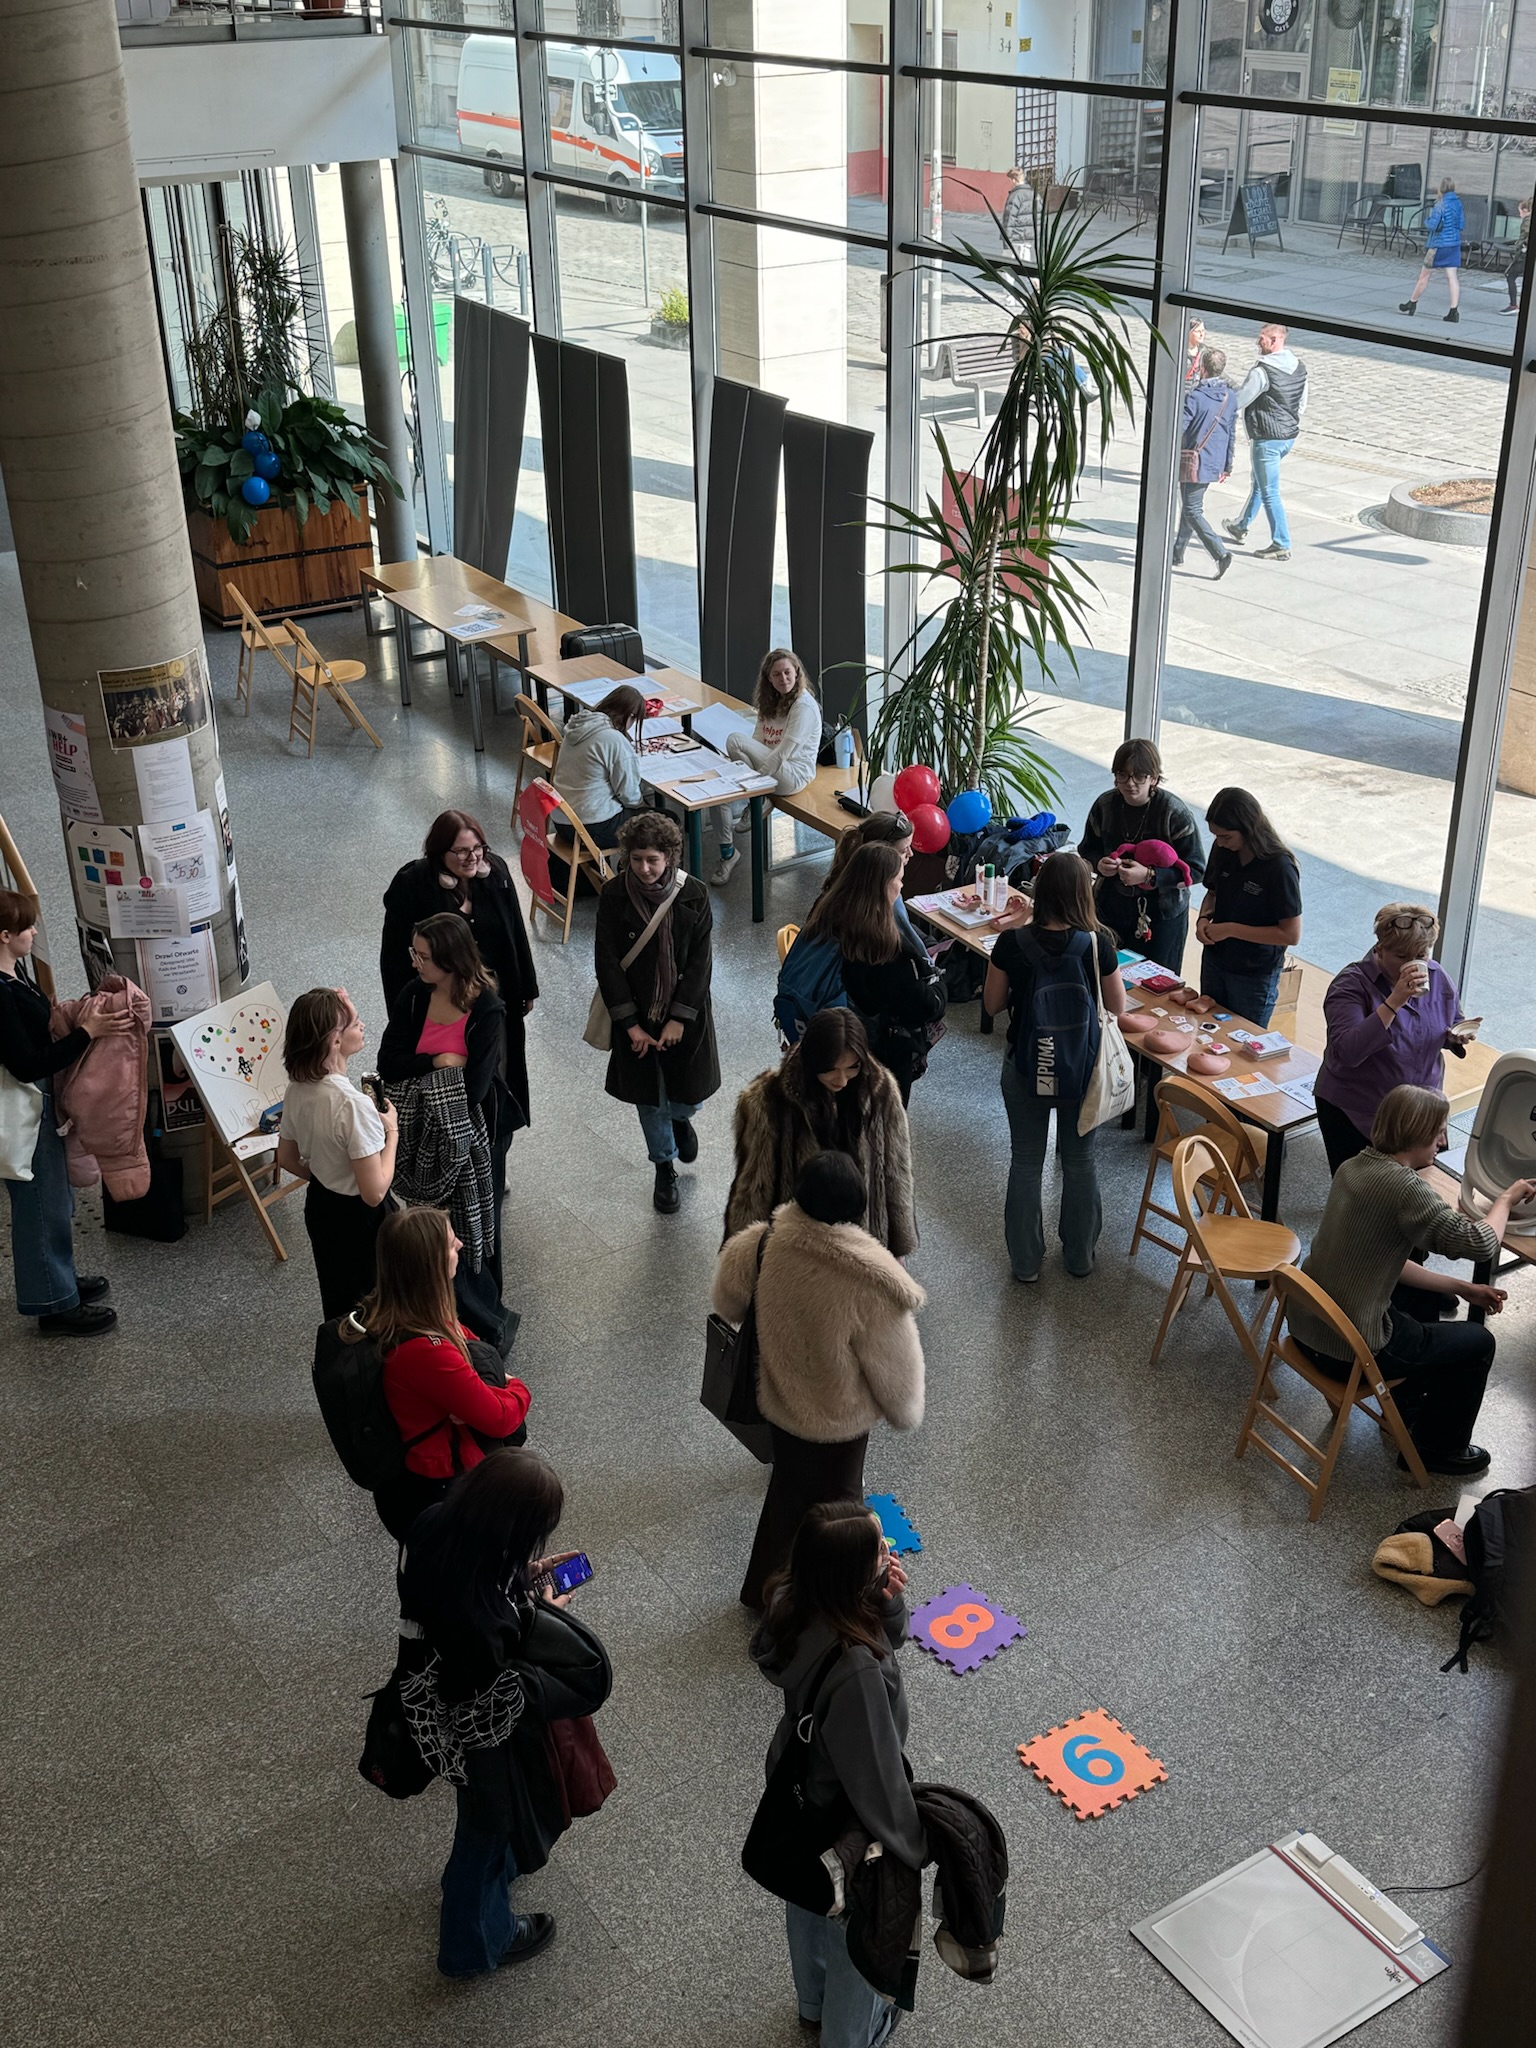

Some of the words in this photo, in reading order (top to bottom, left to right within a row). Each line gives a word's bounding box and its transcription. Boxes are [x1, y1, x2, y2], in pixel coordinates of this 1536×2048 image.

[999, 37, 1011, 53] 34
[52, 739, 78, 757] HELP
[1037, 1036, 1055, 1075] PUMA
[221, 1098, 265, 1135] UWR
[929, 1603, 994, 1649] 8
